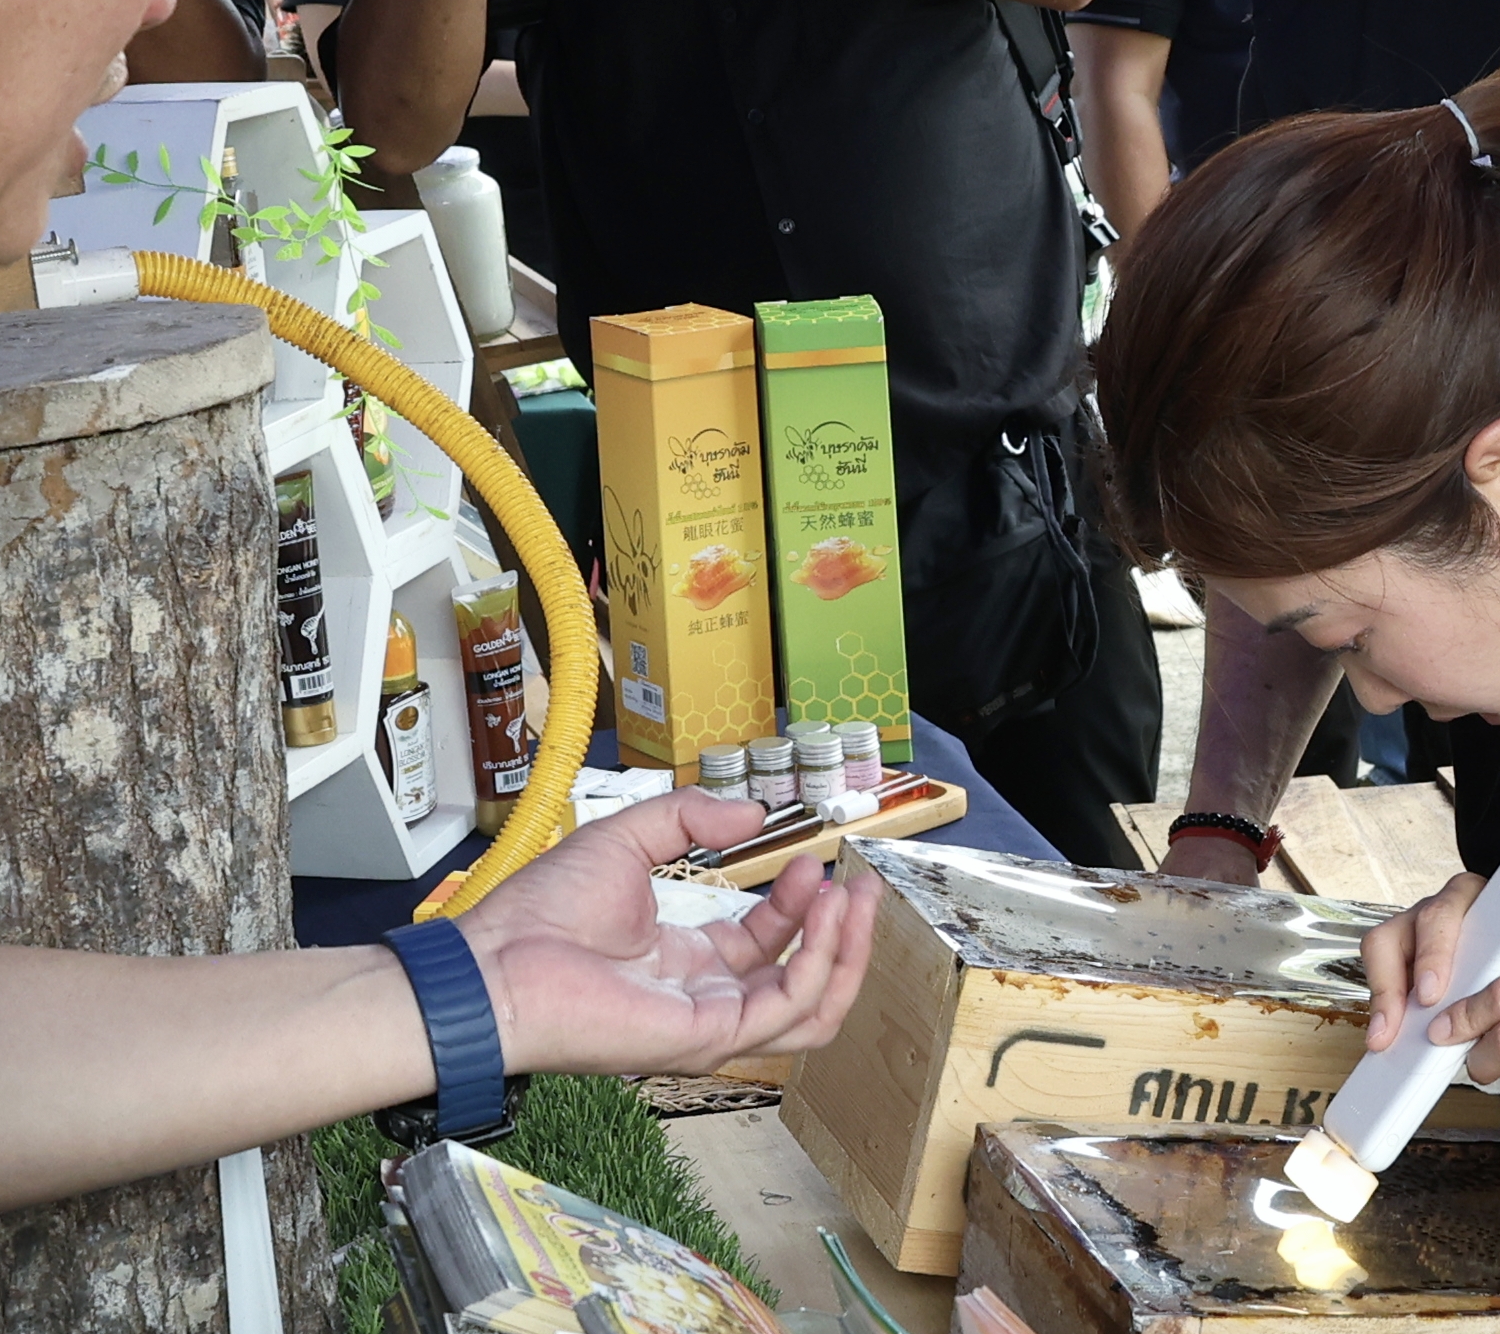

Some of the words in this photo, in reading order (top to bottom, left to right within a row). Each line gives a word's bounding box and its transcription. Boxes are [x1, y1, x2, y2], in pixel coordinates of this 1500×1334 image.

[699, 441, 750, 467] บุษราคัม
[820, 437, 880, 462] บุษราคัม
[800, 510, 875, 532] 天然蜂蜜
[687, 610, 750, 637] 純正蜂蜜
[473, 638, 506, 654] GOLDEN
